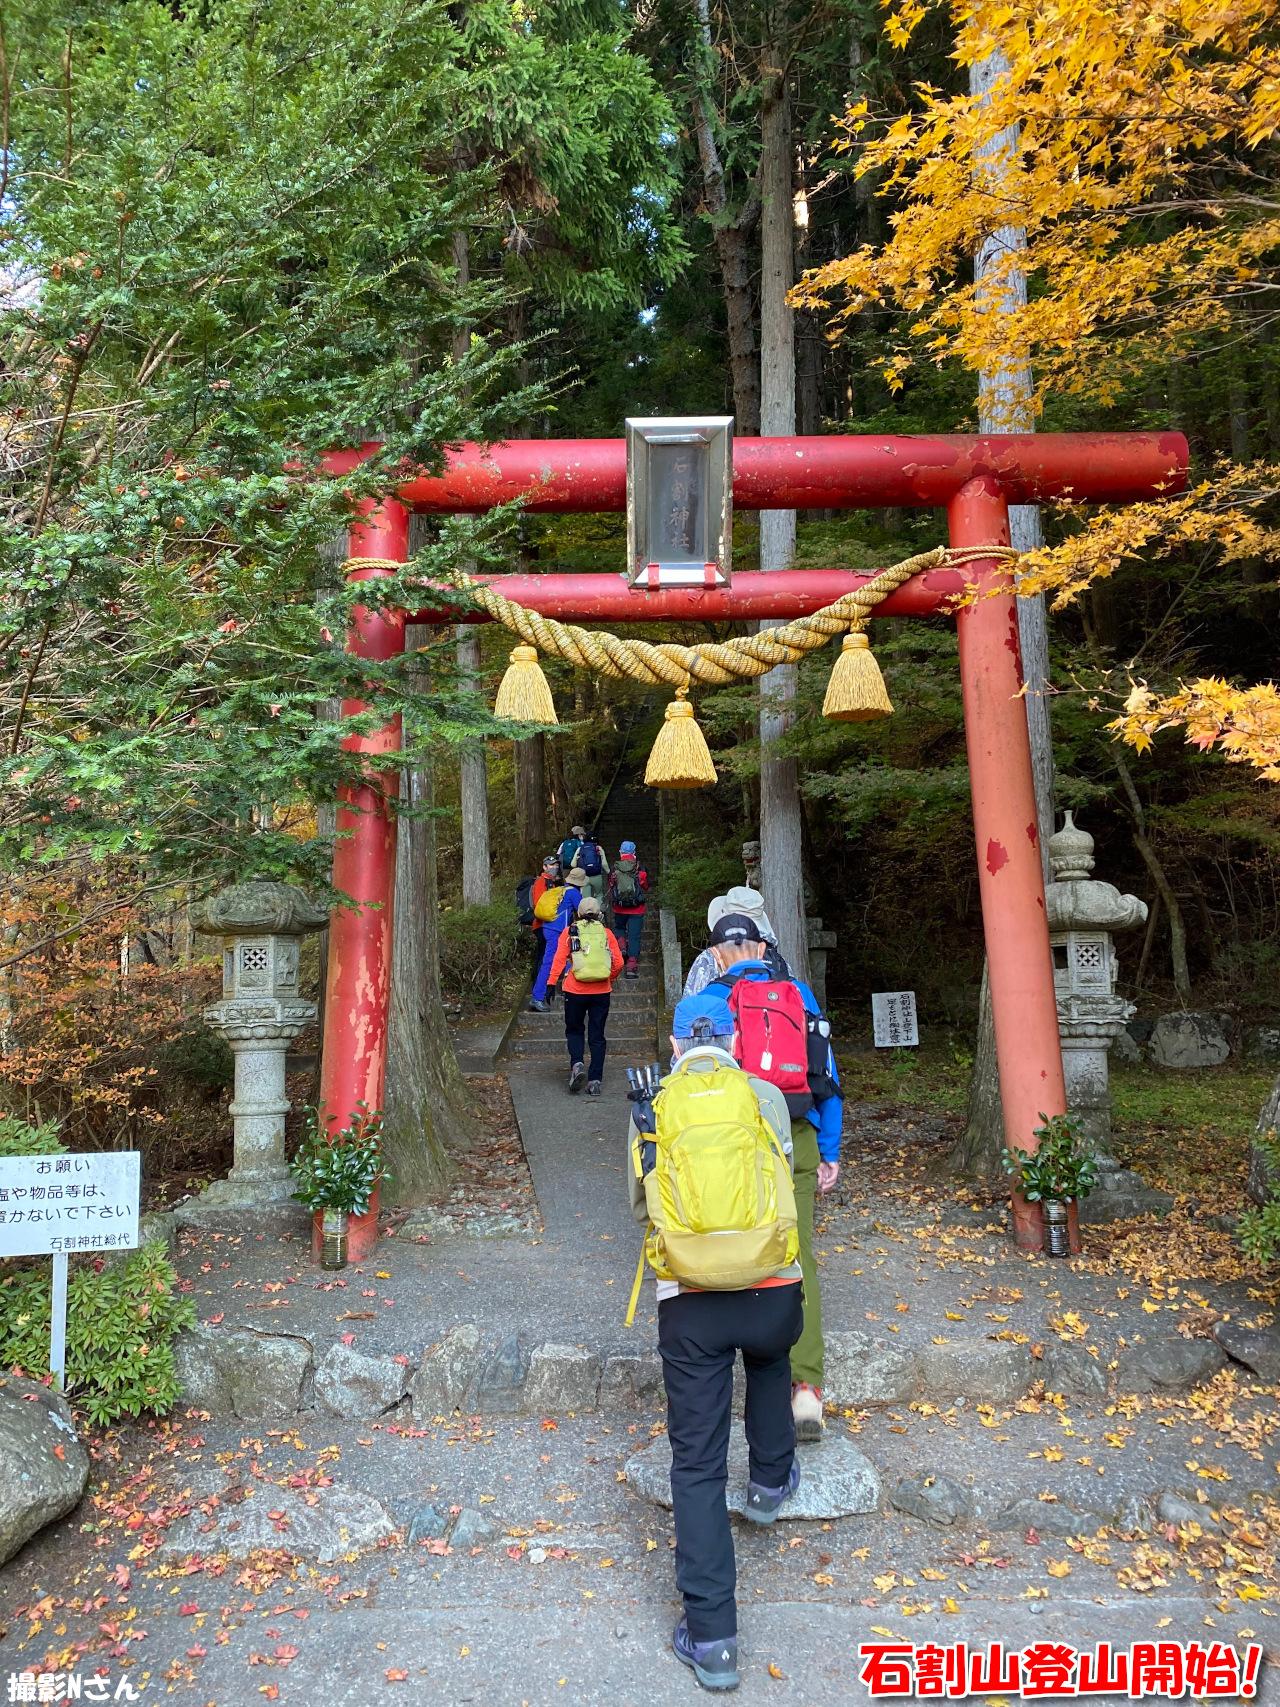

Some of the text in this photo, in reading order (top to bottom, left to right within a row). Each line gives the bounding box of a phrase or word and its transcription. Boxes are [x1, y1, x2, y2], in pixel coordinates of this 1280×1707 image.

[669, 457, 690, 549] 石割神社
[36, 1159, 90, 1175] お願い
[49, 1232, 131, 1250] 石割神社総代
